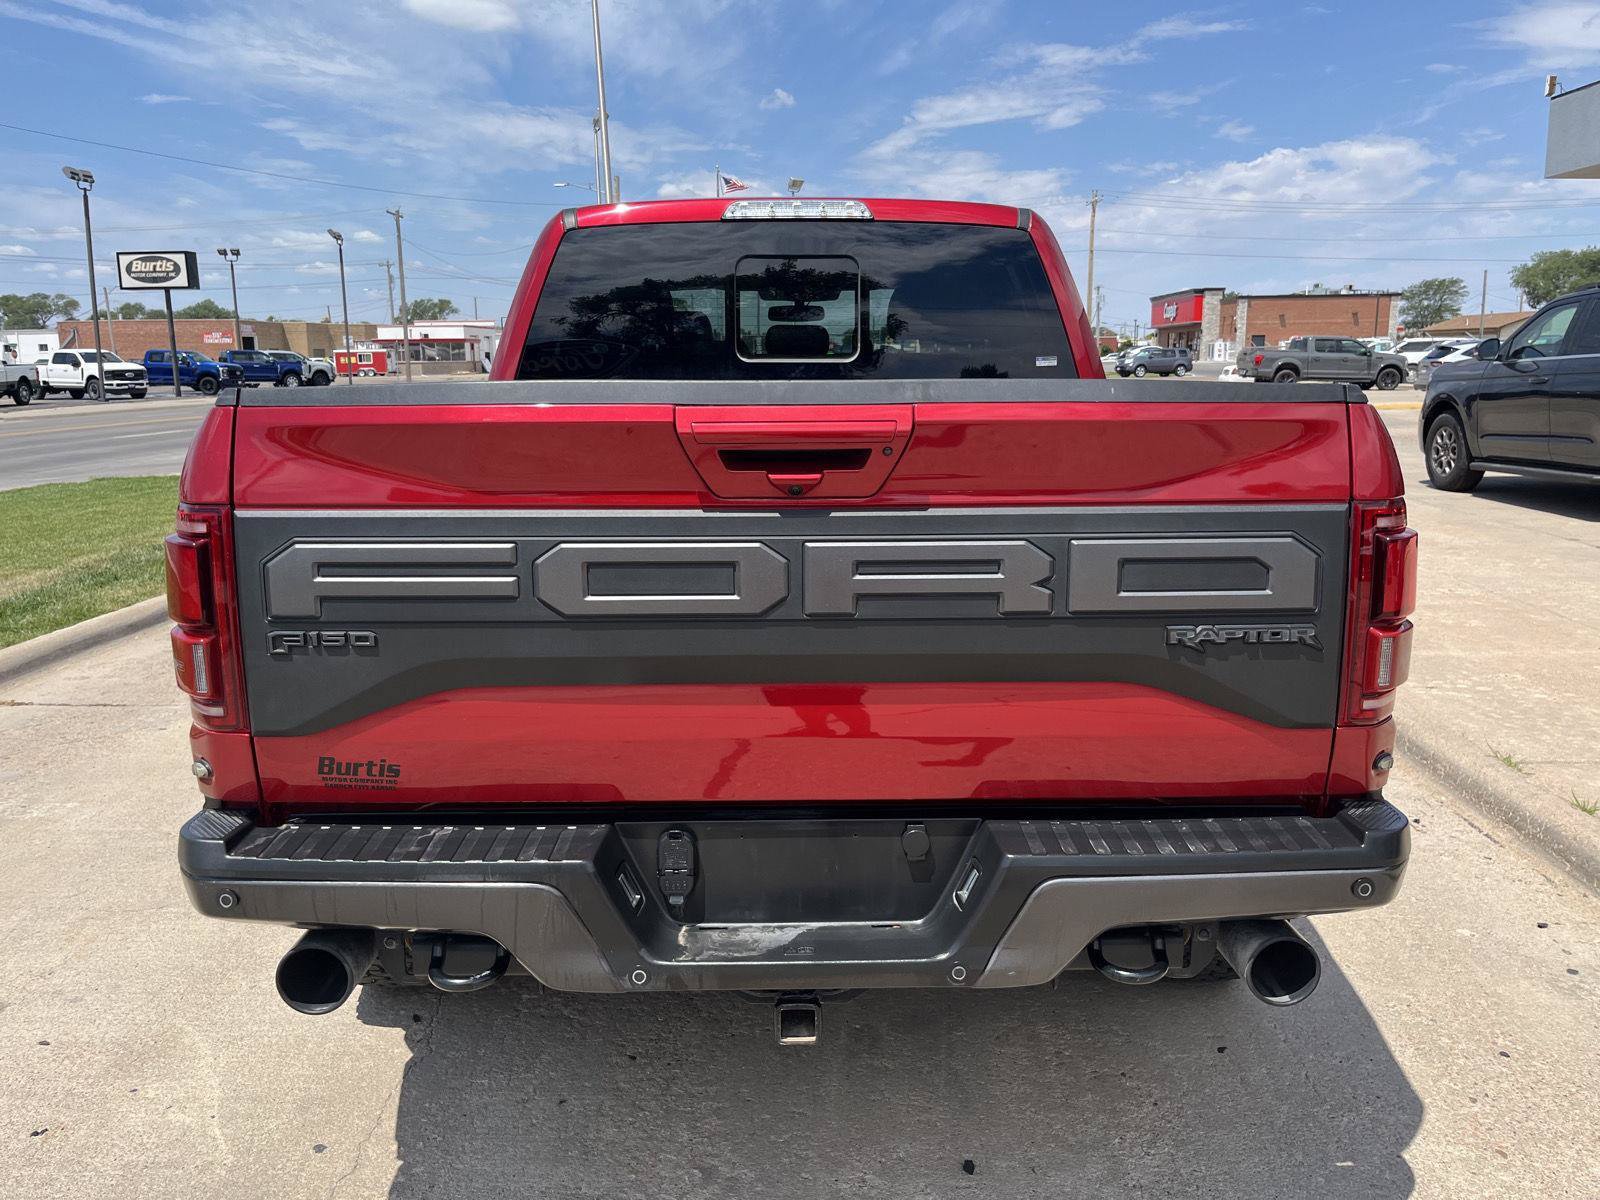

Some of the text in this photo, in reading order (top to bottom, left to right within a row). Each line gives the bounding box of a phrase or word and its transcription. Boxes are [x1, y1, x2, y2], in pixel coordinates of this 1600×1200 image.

[131, 260, 174, 272] Burtis
[264, 537, 1319, 618] FORD
[1166, 624, 1323, 653] RAPTOR
[318, 757, 401, 778] Burtis
